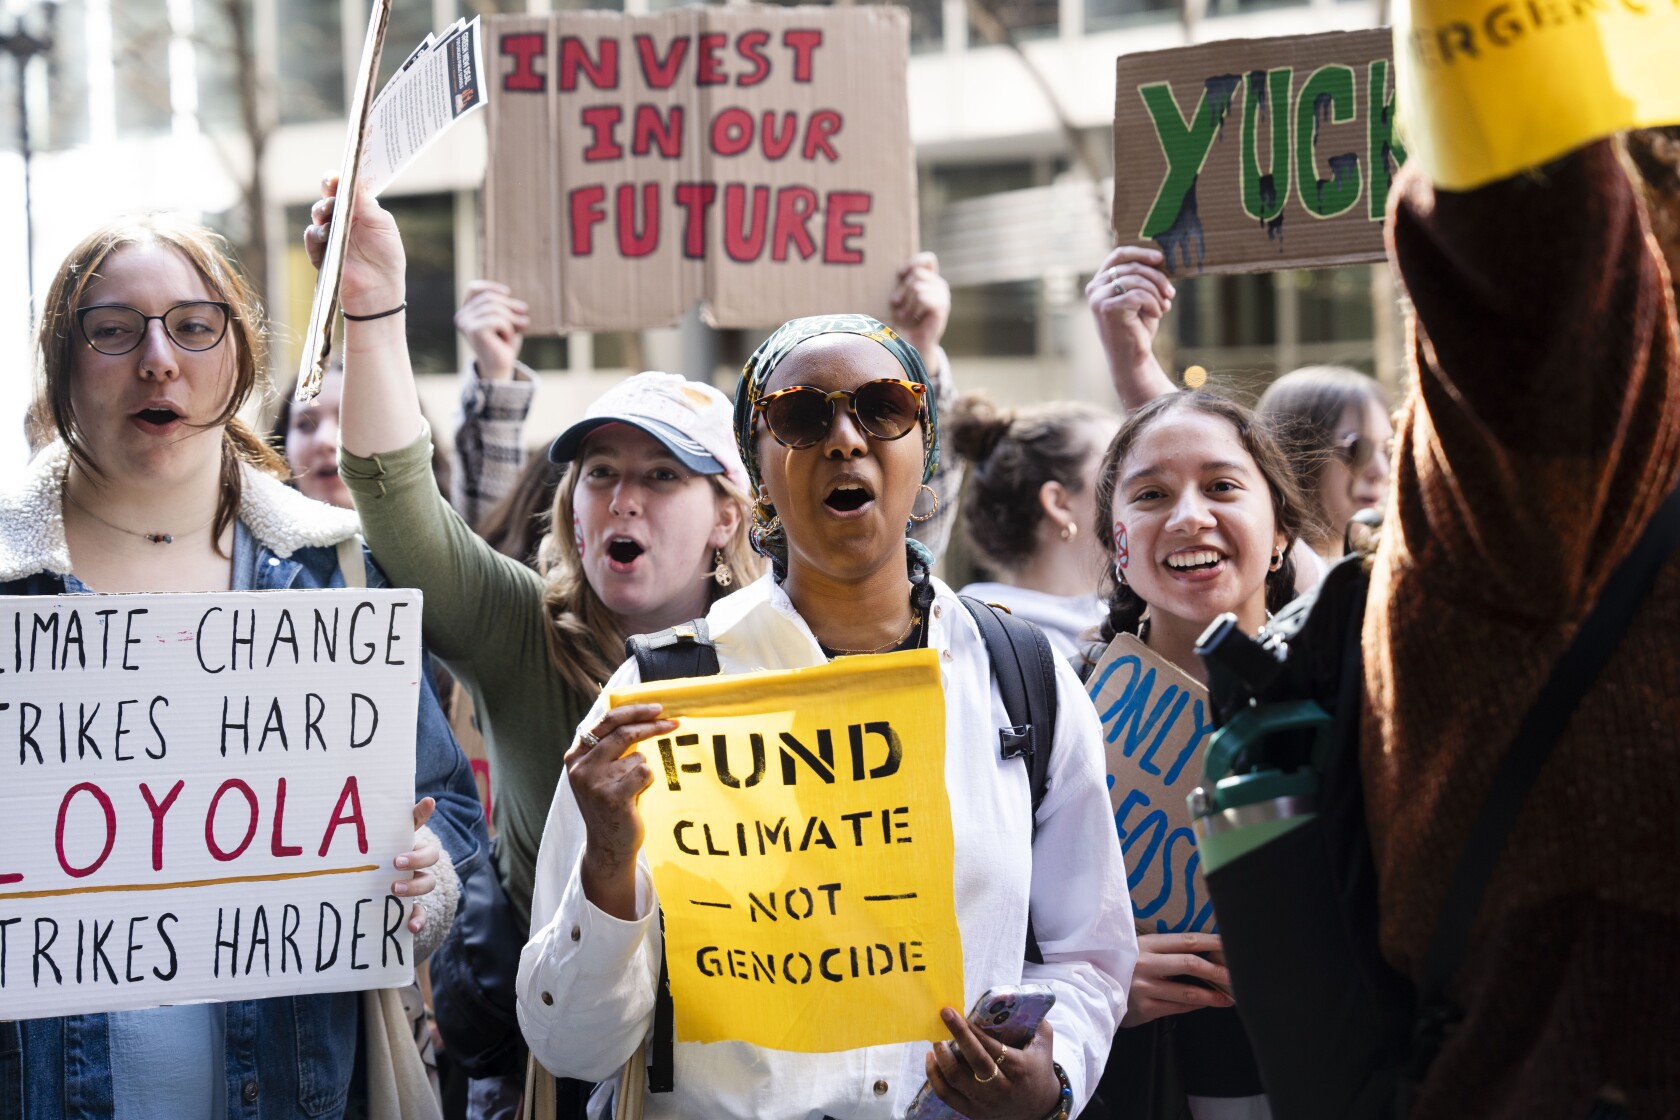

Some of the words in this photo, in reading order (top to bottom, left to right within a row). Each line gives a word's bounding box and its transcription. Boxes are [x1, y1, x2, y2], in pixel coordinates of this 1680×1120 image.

[461, 31, 469, 54] GREEN
[462, 51, 470, 69] NEW
[500, 28, 822, 93] INVEST
[582, 103, 684, 163] IN
[710, 108, 844, 163] OUR
[569, 181, 872, 265] FUTURE
[0, 608, 148, 674] IMATE
[196, 601, 409, 674] CHANGE
[0, 696, 169, 765] RIKES
[220, 693, 379, 757] HARD
[658, 721, 903, 791] FUND
[673, 806, 912, 856] CLIMATE
[748, 883, 842, 923] NOT
[214, 895, 405, 978] HARDER
[696, 941, 926, 985] GENOCIDE
